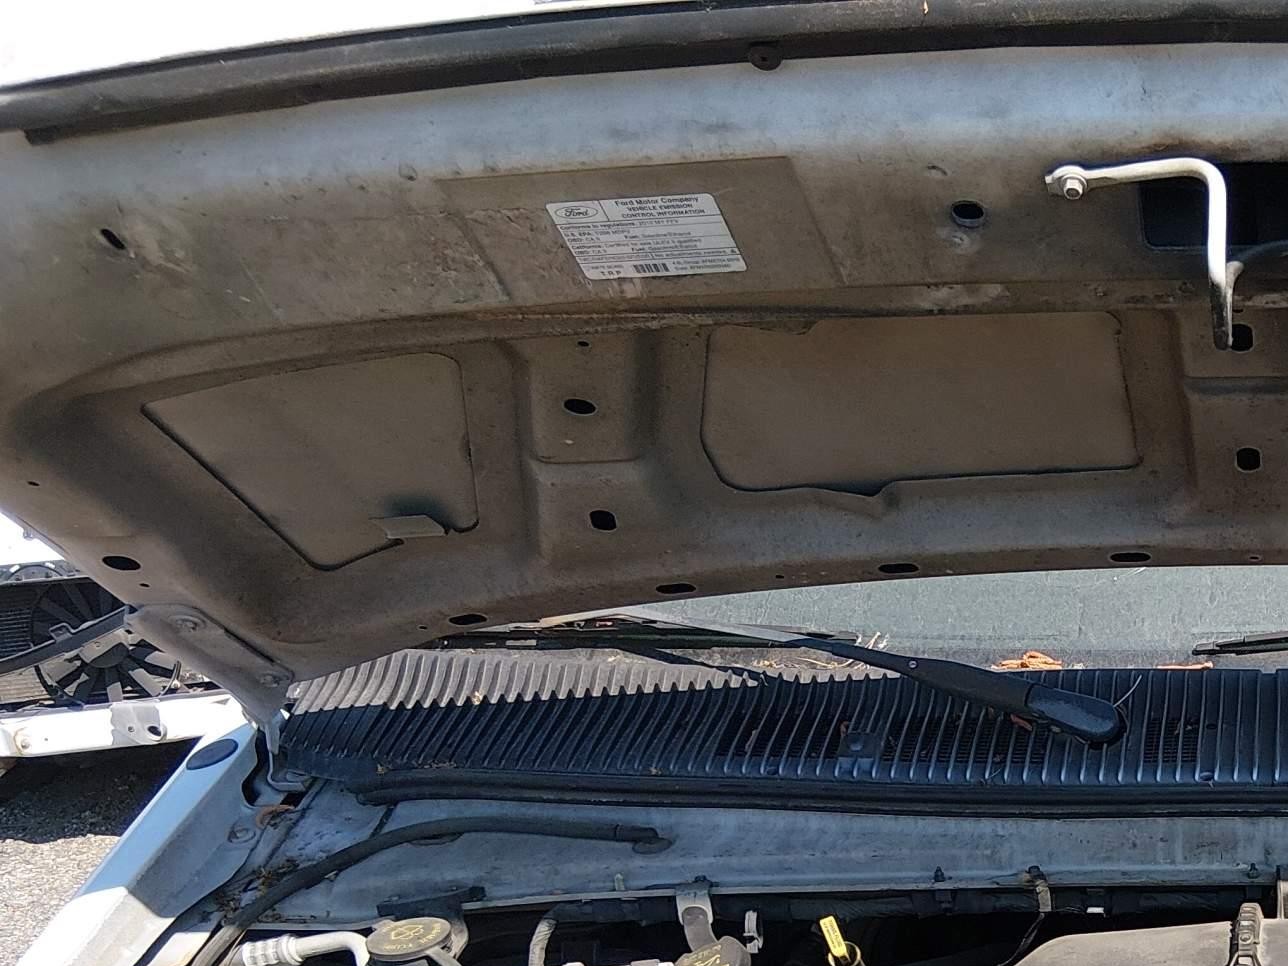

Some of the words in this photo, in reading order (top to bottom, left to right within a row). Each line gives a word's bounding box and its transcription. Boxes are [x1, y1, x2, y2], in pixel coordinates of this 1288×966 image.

[615, 199, 634, 208] Ford
[637, 198, 658, 206] Motor
[660, 196, 699, 204] Company
[627, 204, 657, 212] VEHICLE
[657, 209, 705, 217] INFORMATION
